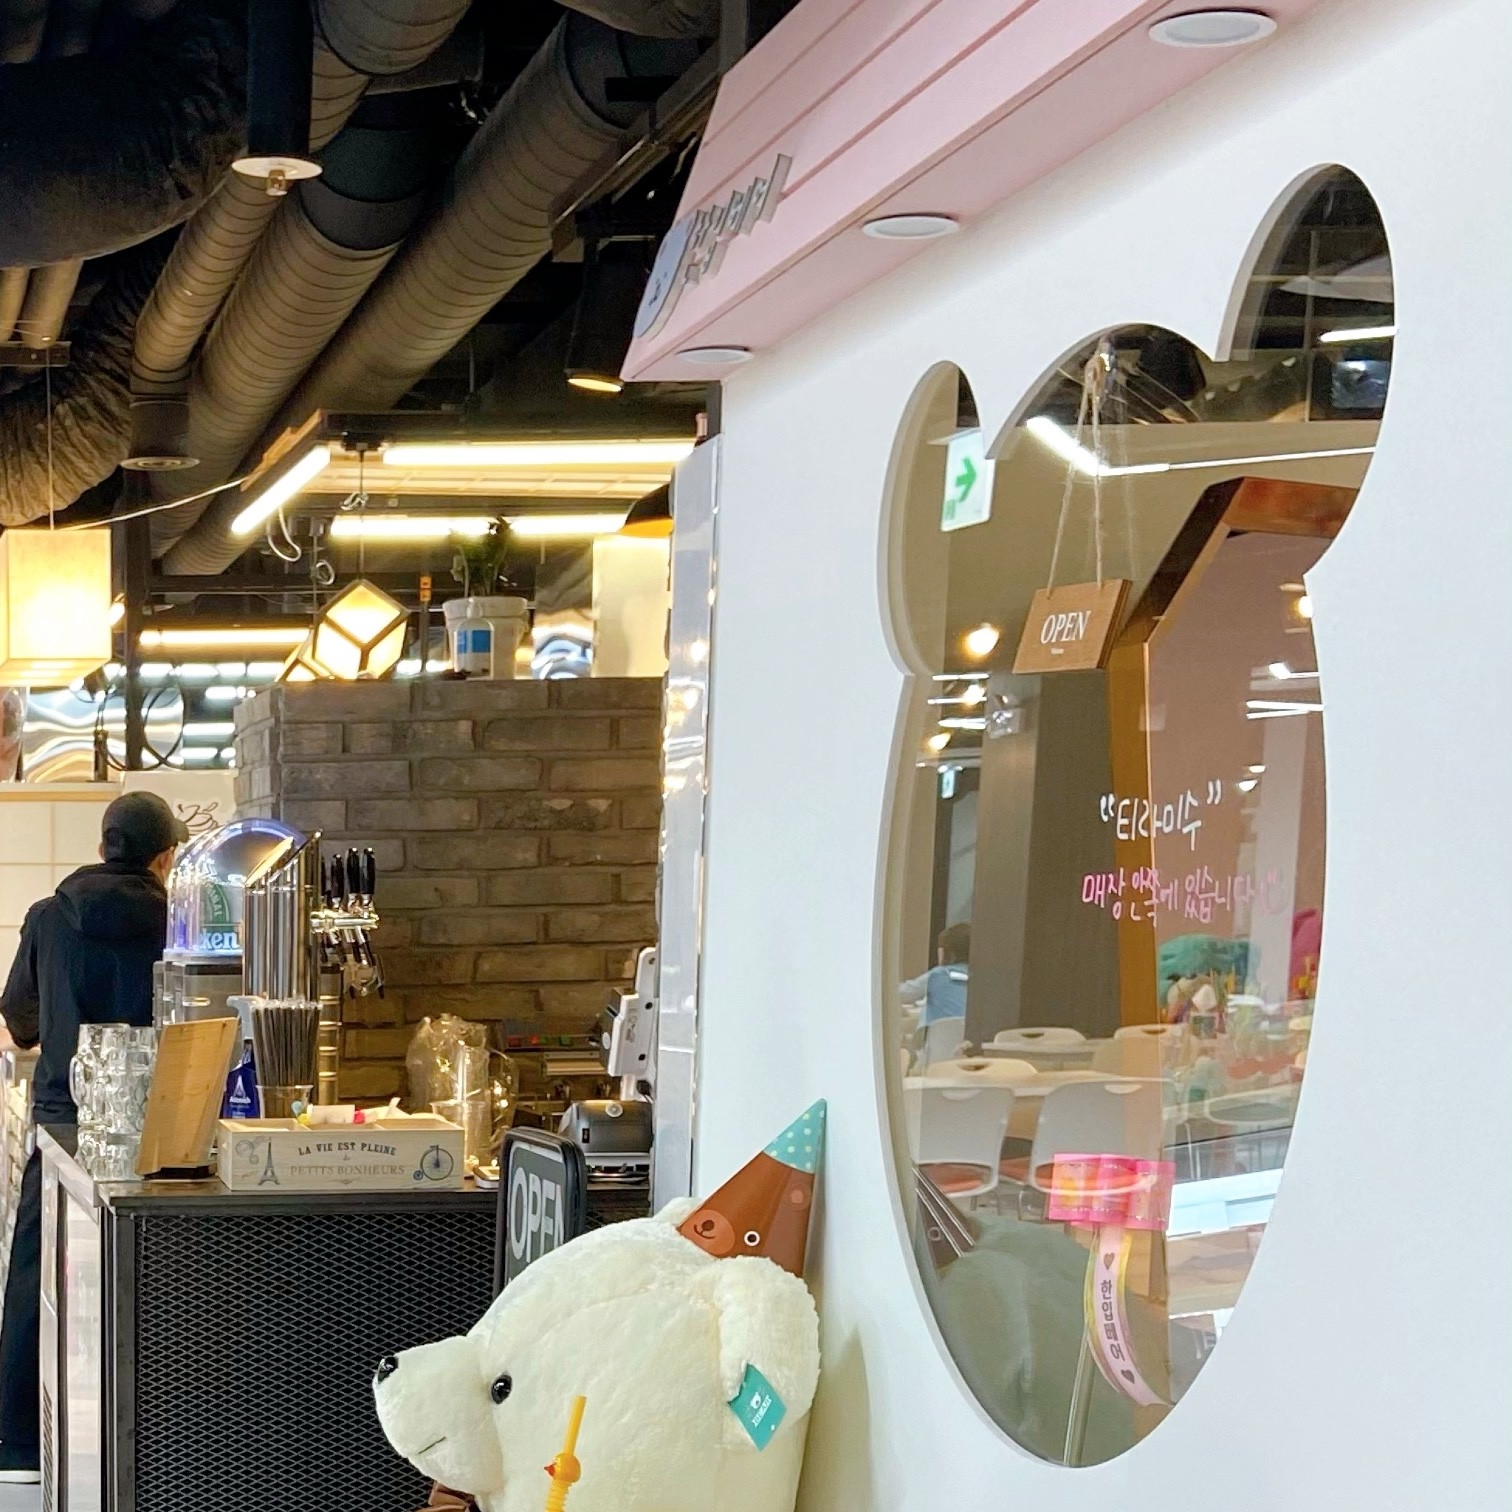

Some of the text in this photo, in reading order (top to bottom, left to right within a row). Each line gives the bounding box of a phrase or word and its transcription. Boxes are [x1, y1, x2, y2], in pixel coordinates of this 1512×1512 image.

[1040, 610, 1092, 645] OPEN
[1081, 866, 1126, 921] 매장
[1131, 866, 1179, 928] 안쪽에
[298, 1142, 397, 1156] LA VIE EST PLEINE
[290, 1165, 405, 1176] PETITS BONHEURS
